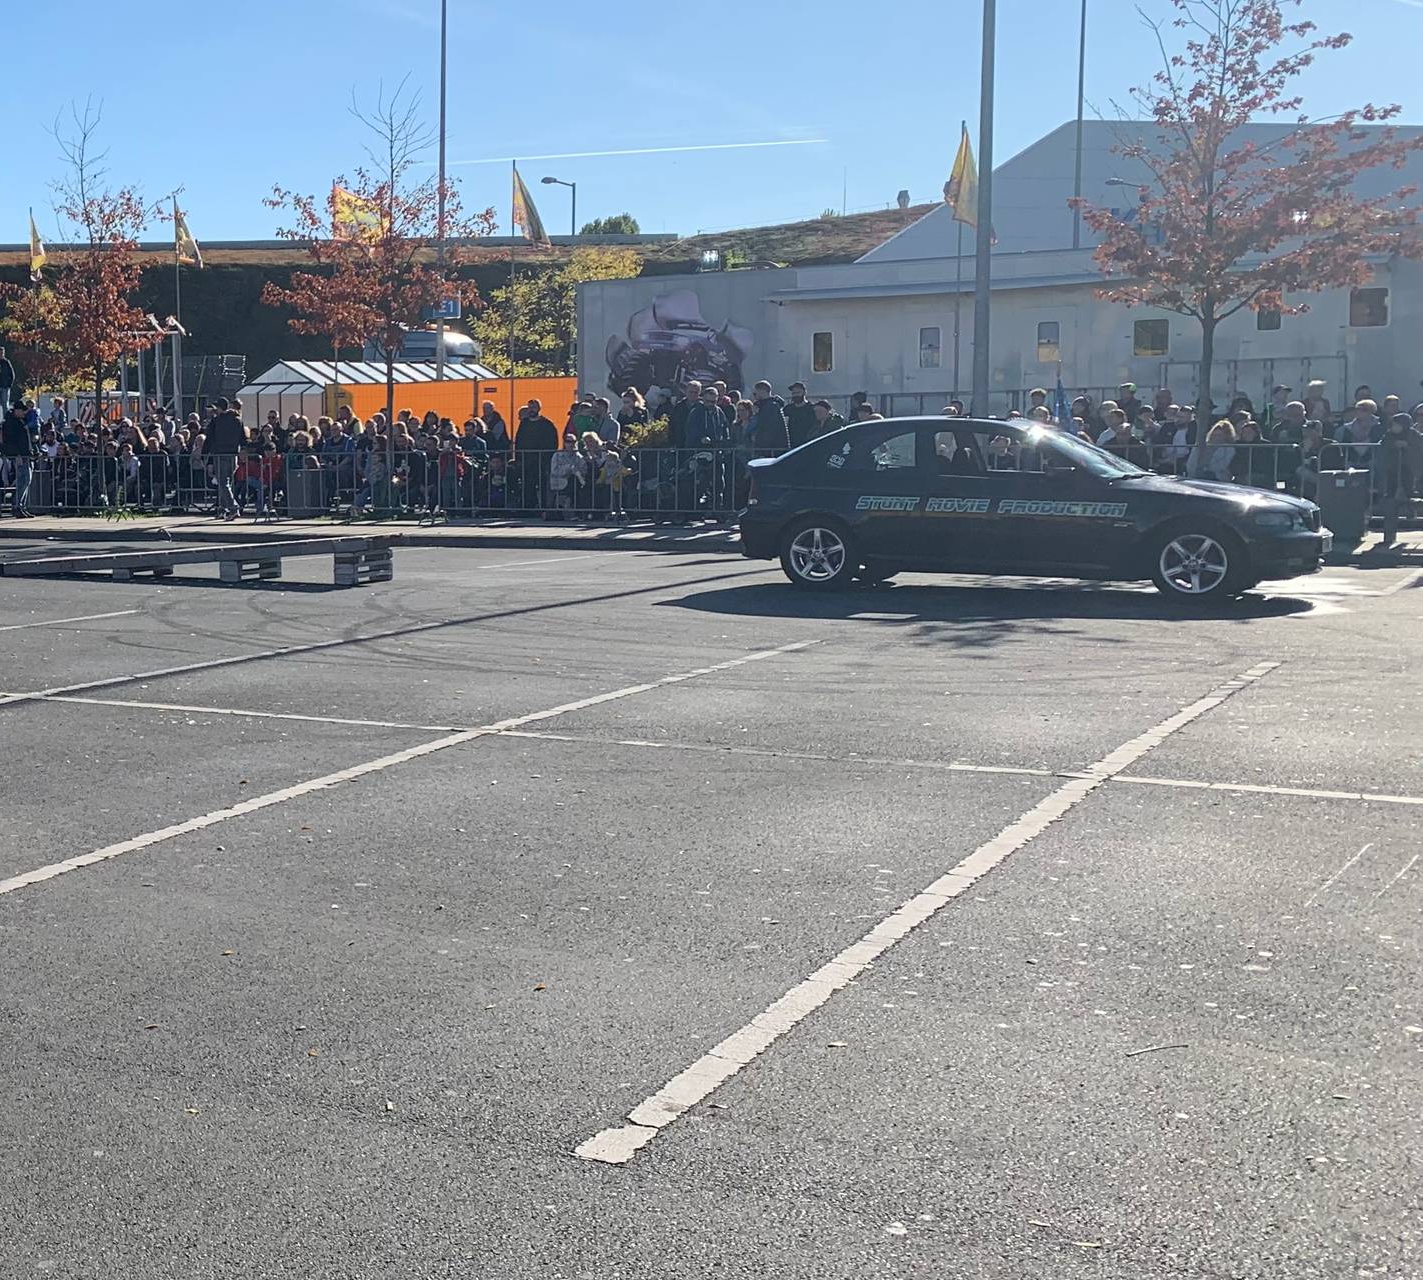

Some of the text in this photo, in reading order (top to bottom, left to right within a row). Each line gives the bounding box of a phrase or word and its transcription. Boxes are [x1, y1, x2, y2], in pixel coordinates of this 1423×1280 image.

[856, 495, 1128, 518] STUNT MOVIE PRODUCTION
